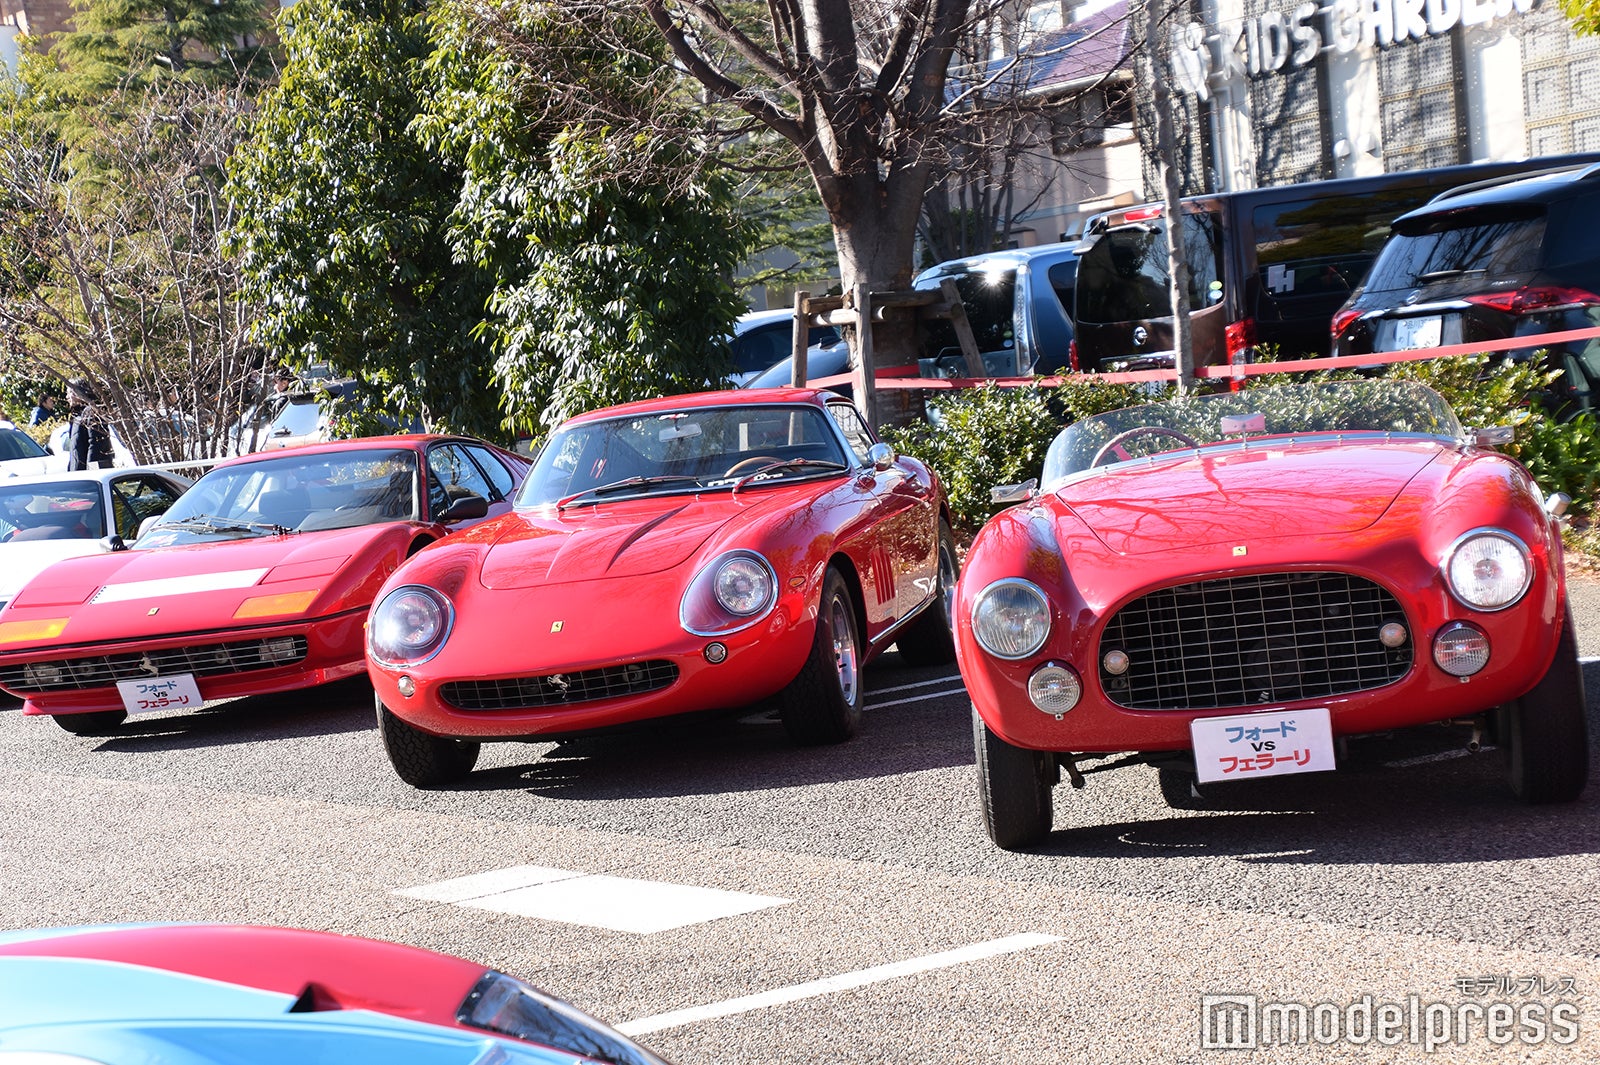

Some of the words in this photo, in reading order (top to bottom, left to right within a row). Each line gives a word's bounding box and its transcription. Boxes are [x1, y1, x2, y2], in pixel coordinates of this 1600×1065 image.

[1220, 2, 1321, 81] KIDS
[1331, 0, 1533, 53] GARD
[136, 681, 177, 694] フォード
[137, 695, 189, 709] フェラーリ
[1225, 720, 1297, 743] フォード
[1219, 749, 1312, 773] フェラーリ
